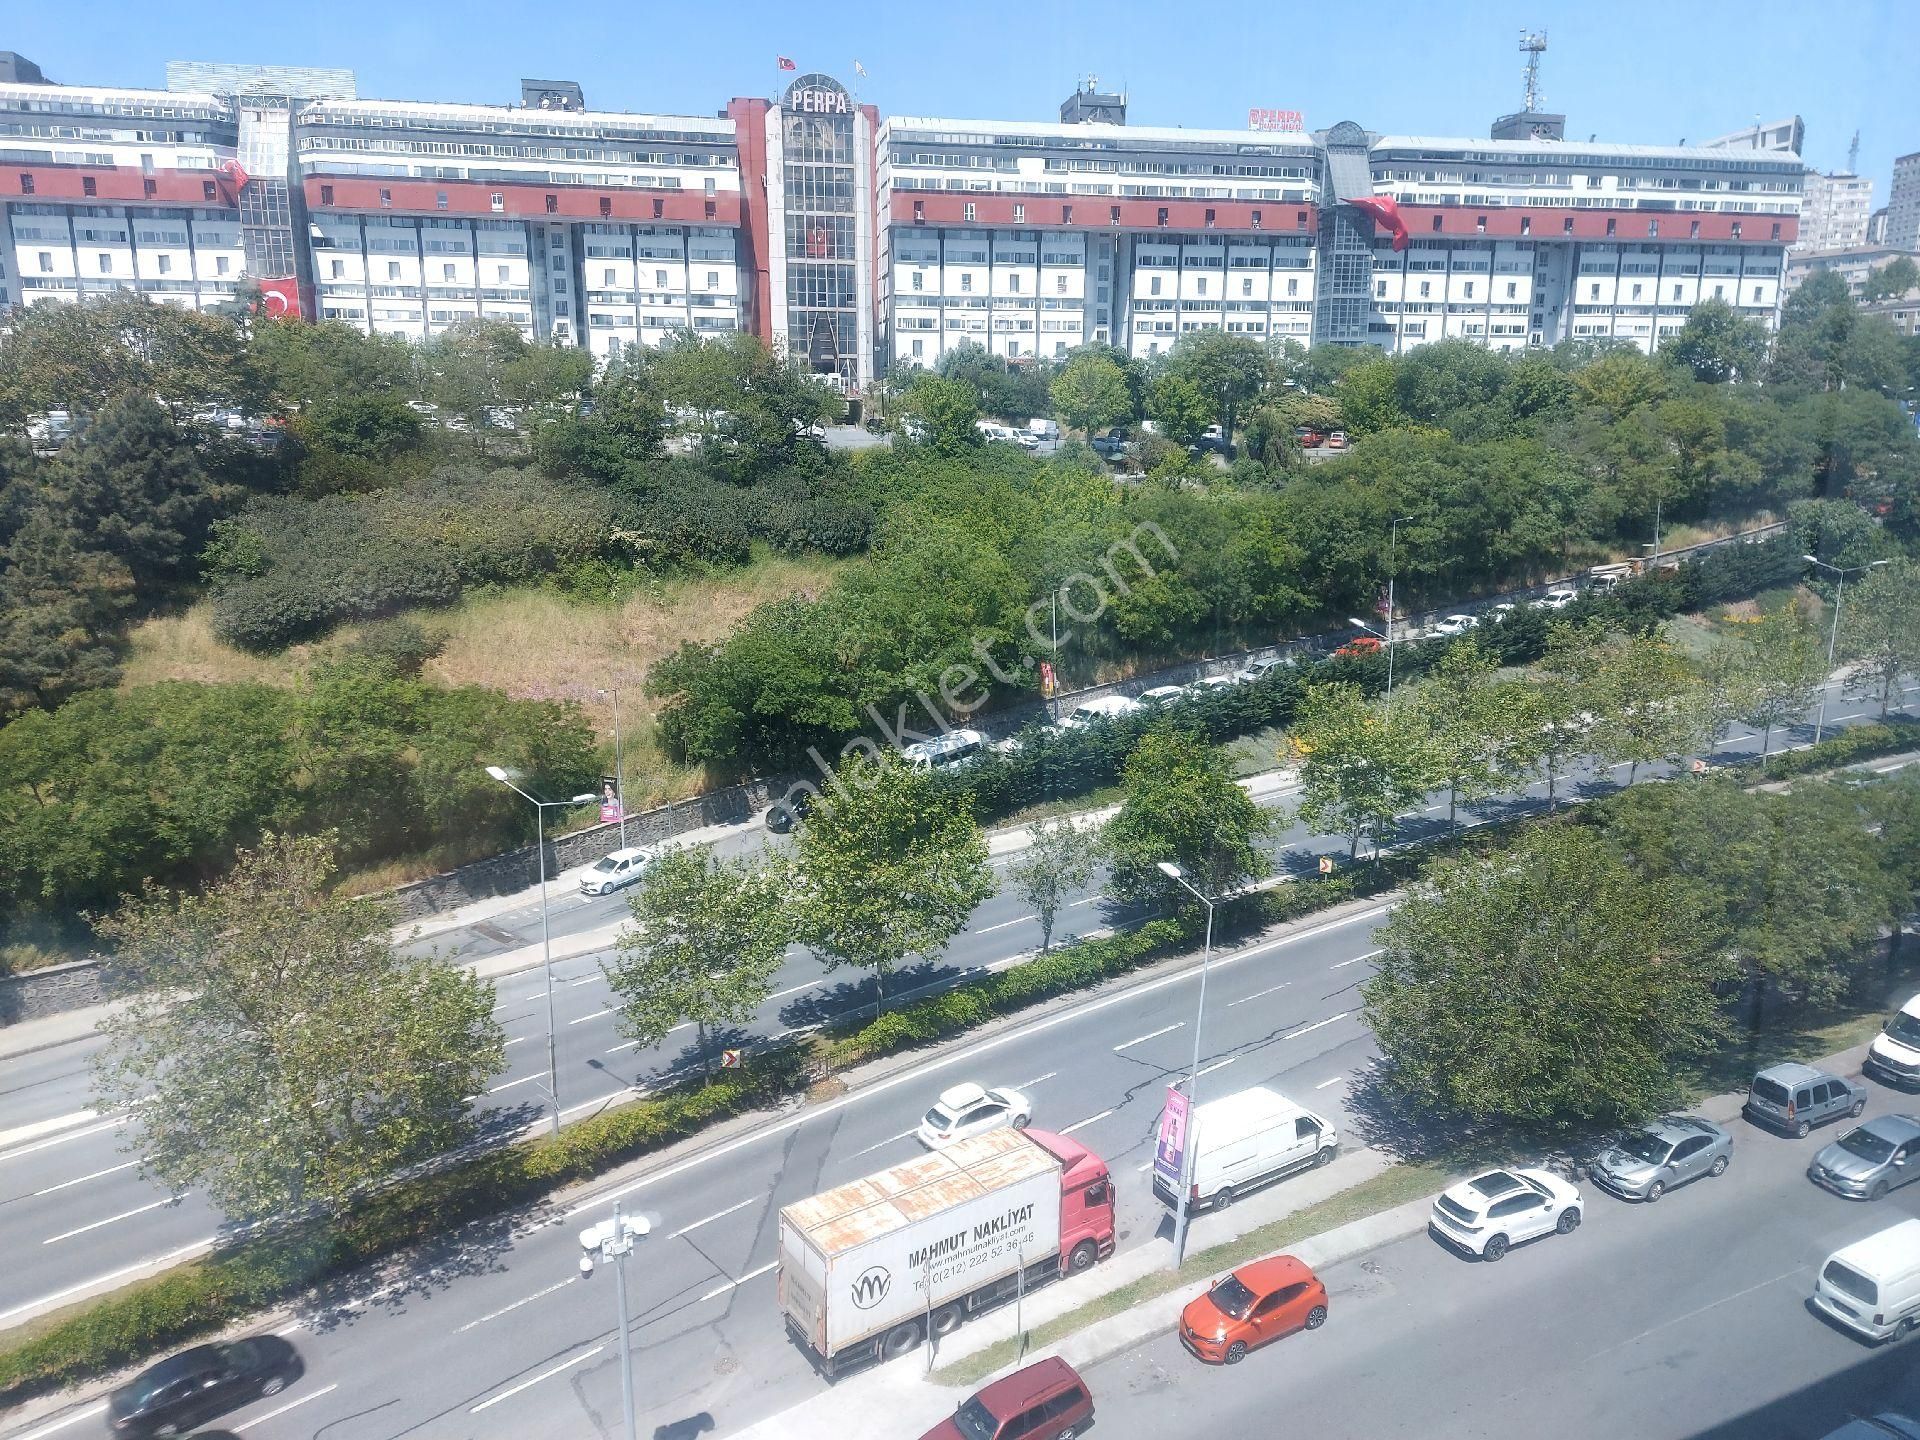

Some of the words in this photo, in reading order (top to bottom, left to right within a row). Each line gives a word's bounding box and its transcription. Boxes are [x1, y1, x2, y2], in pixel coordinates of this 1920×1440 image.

[792, 90, 847, 114] PERPA
[909, 1231, 967, 1269] MAHMUT
[973, 1203, 1034, 1242] NAKLİYAT
[927, 1225, 1026, 1271] ww.mahmutnakliyat.com
[932, 1261, 966, 1284] 0(212)
[969, 1252, 988, 1268] 222
[991, 1245, 1003, 1259] 52
